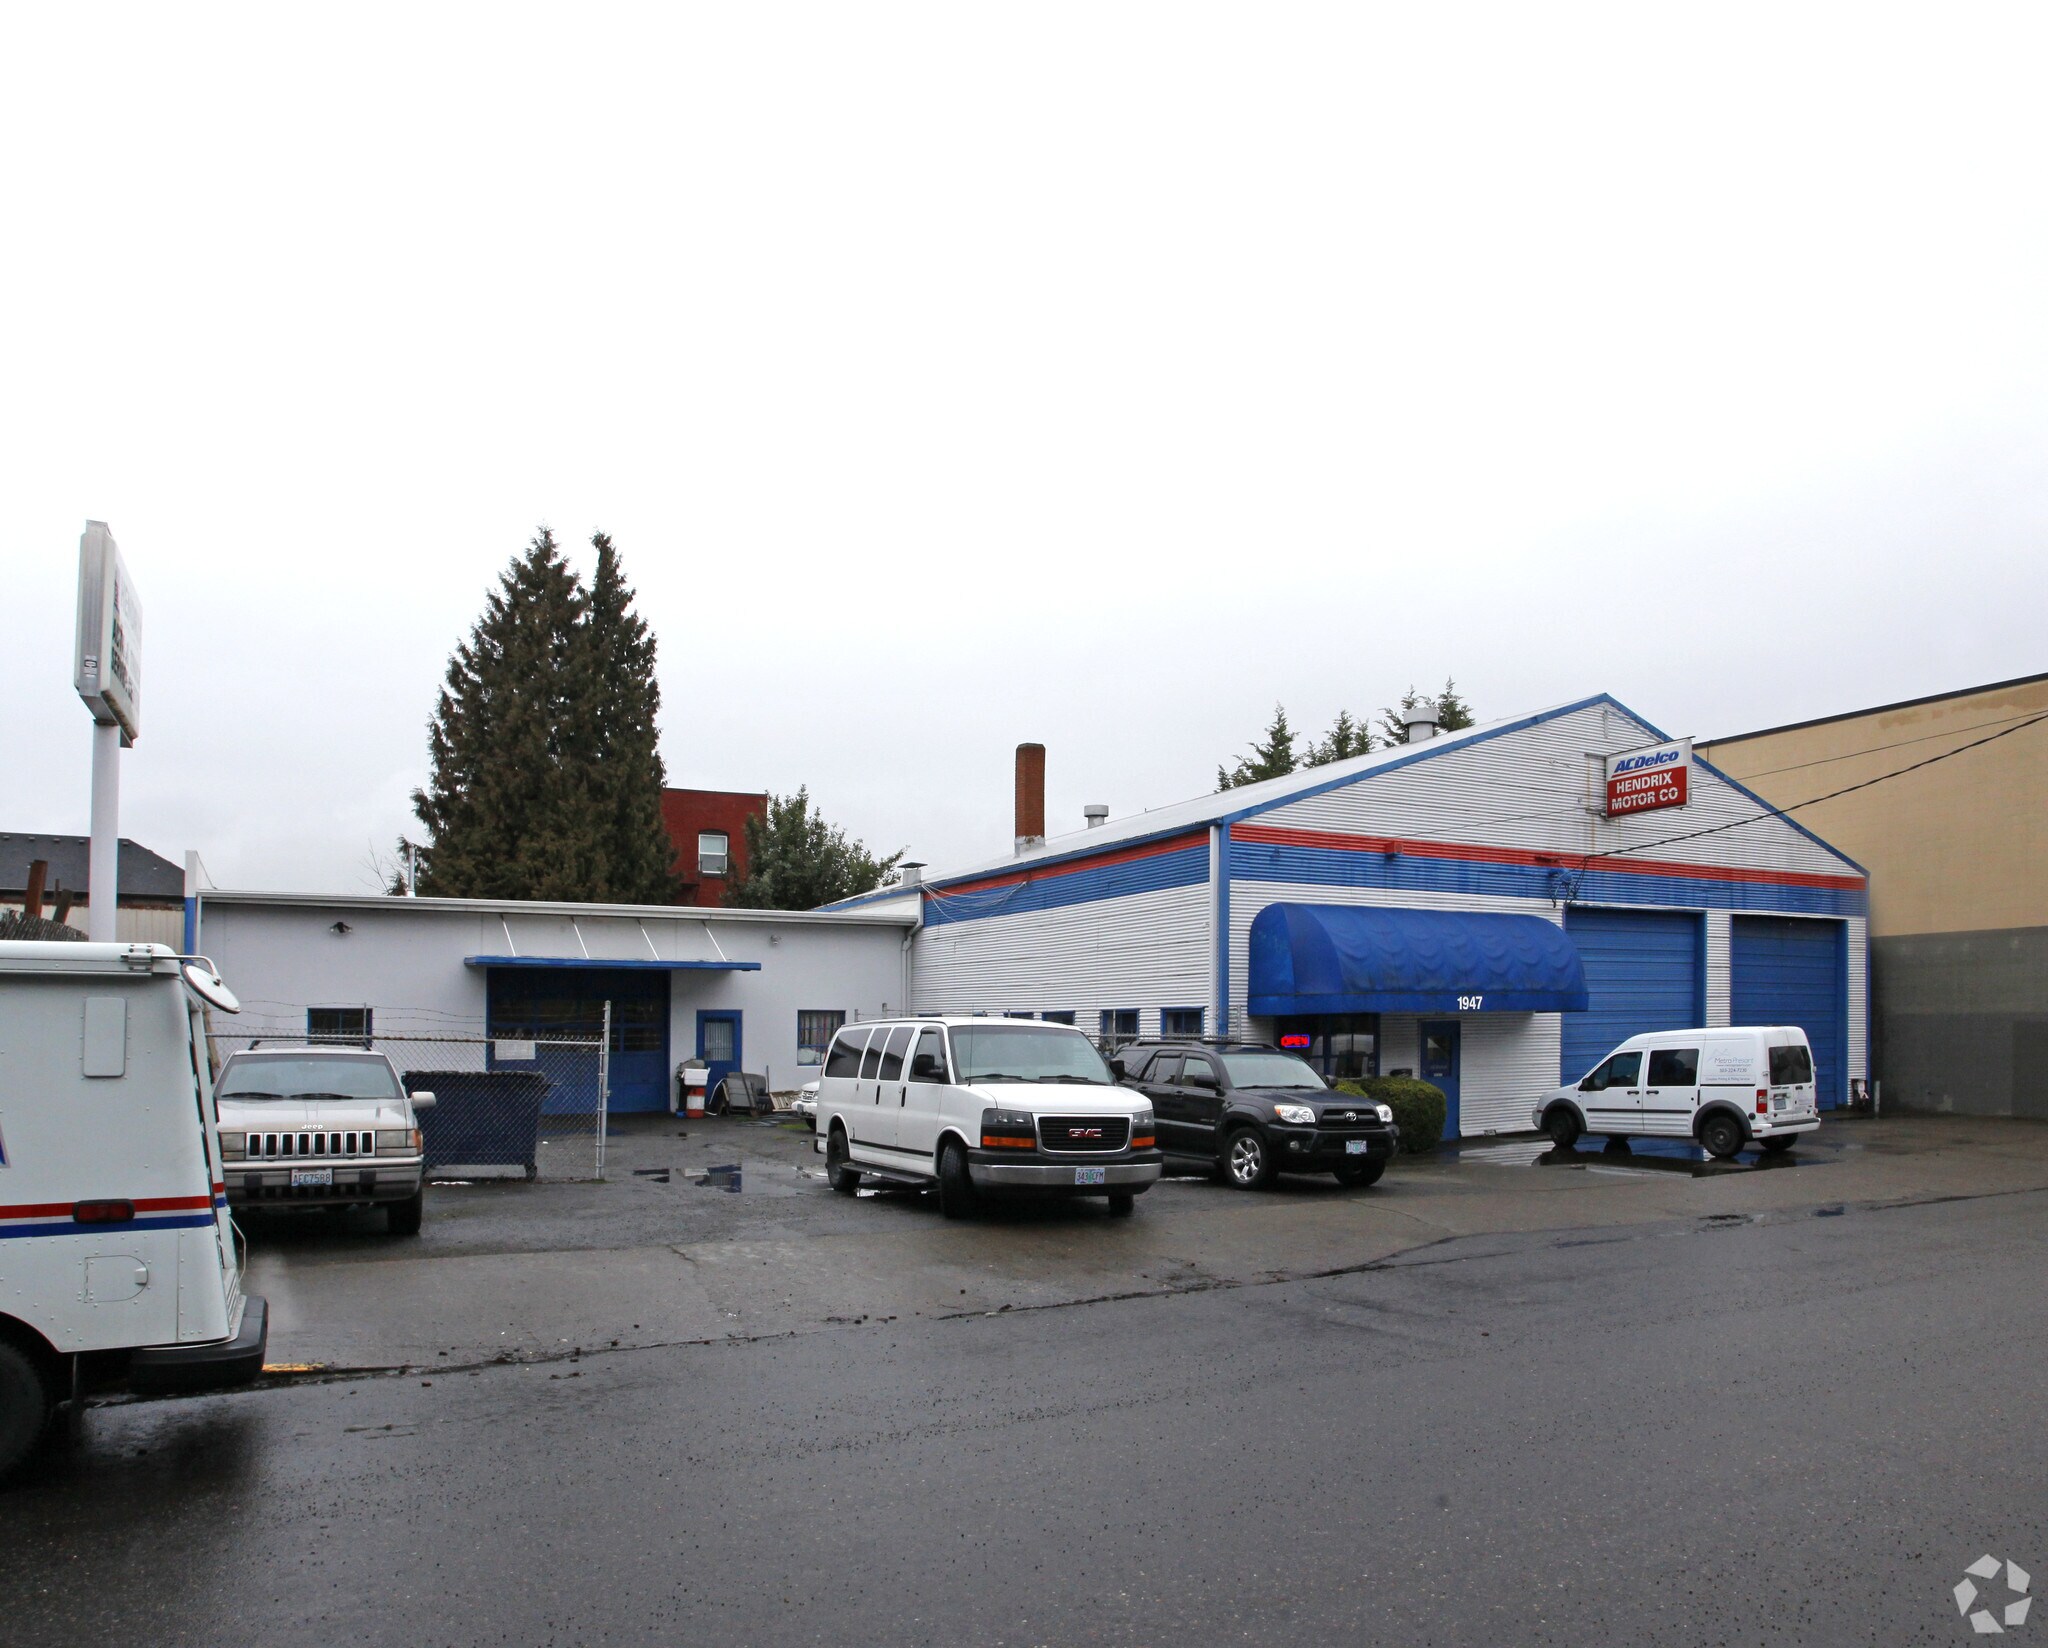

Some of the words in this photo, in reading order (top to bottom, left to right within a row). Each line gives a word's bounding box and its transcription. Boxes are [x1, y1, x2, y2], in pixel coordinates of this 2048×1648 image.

[1614, 750, 1680, 773] ACDelco
[1616, 771, 1673, 794] HENDRIX
[1611, 790, 1656, 811] MOTOR
[1659, 787, 1679, 802] CO
[1457, 996, 1483, 1010] 1947
[1281, 1036, 1309, 1046] OPEN
[1068, 1128, 1103, 1139] GMC
